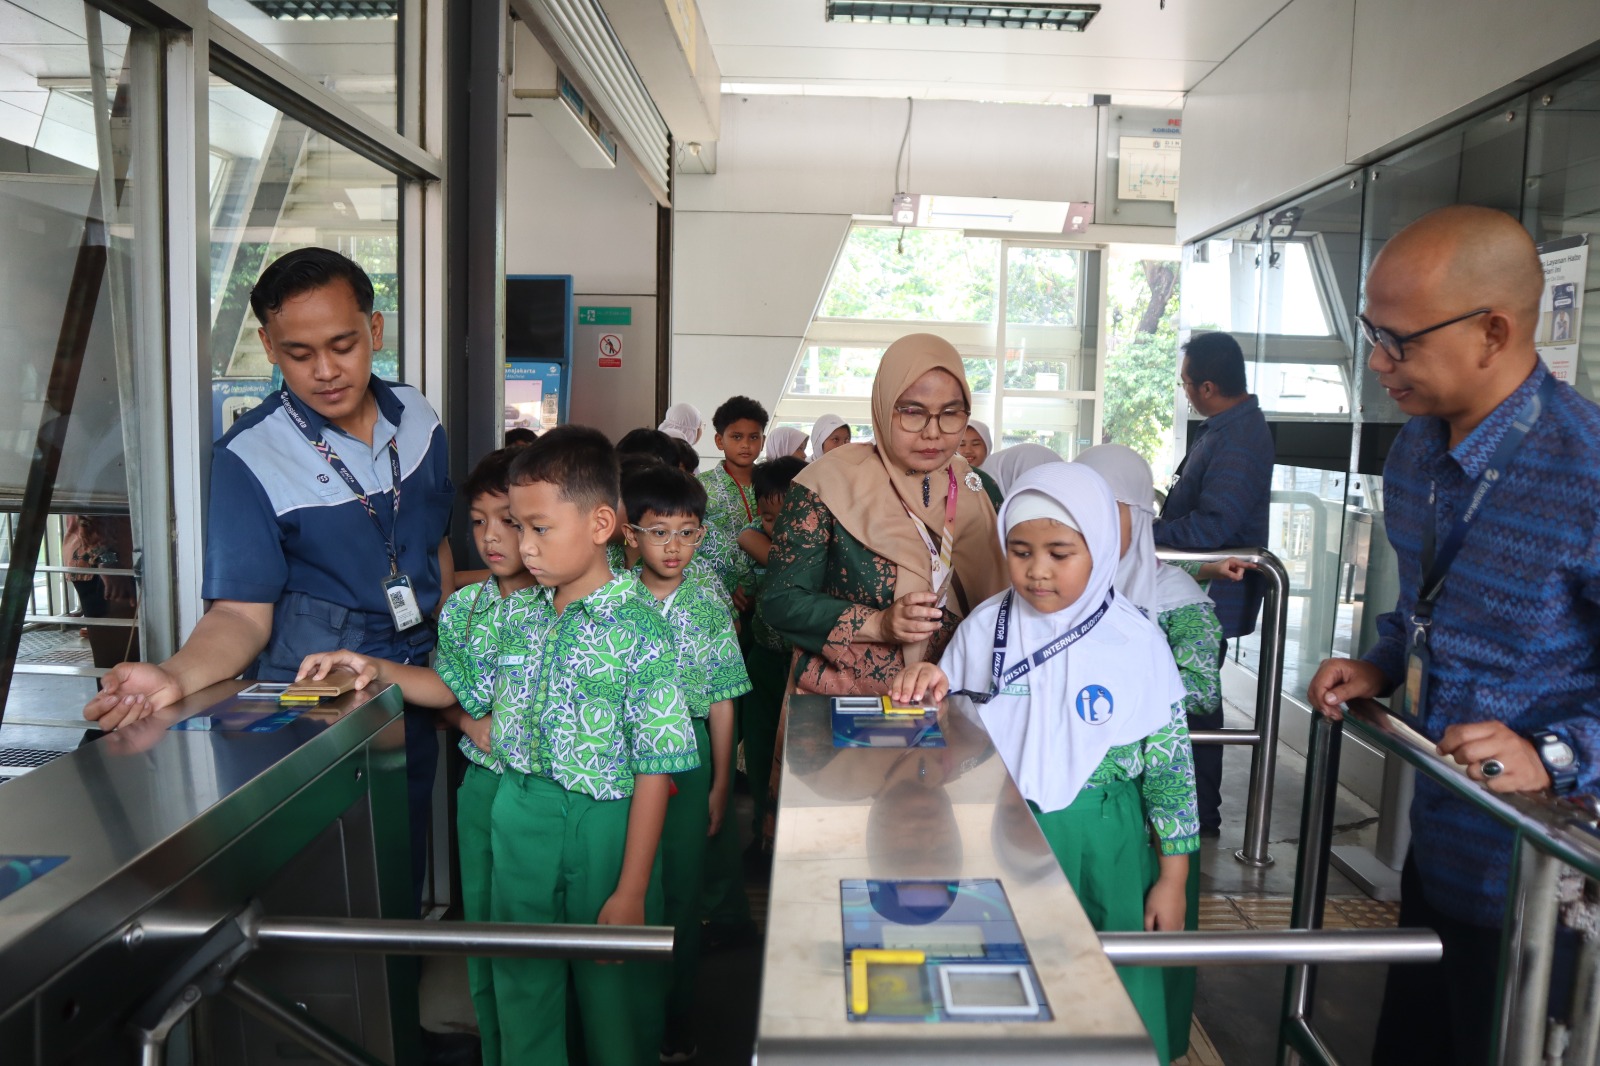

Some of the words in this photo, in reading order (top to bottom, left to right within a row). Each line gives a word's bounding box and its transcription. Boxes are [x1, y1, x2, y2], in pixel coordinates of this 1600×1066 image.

[1463, 480, 1491, 523] transjakarta
[1043, 631, 1080, 658] INTERNAL
[1004, 664, 1028, 682] AISIN
